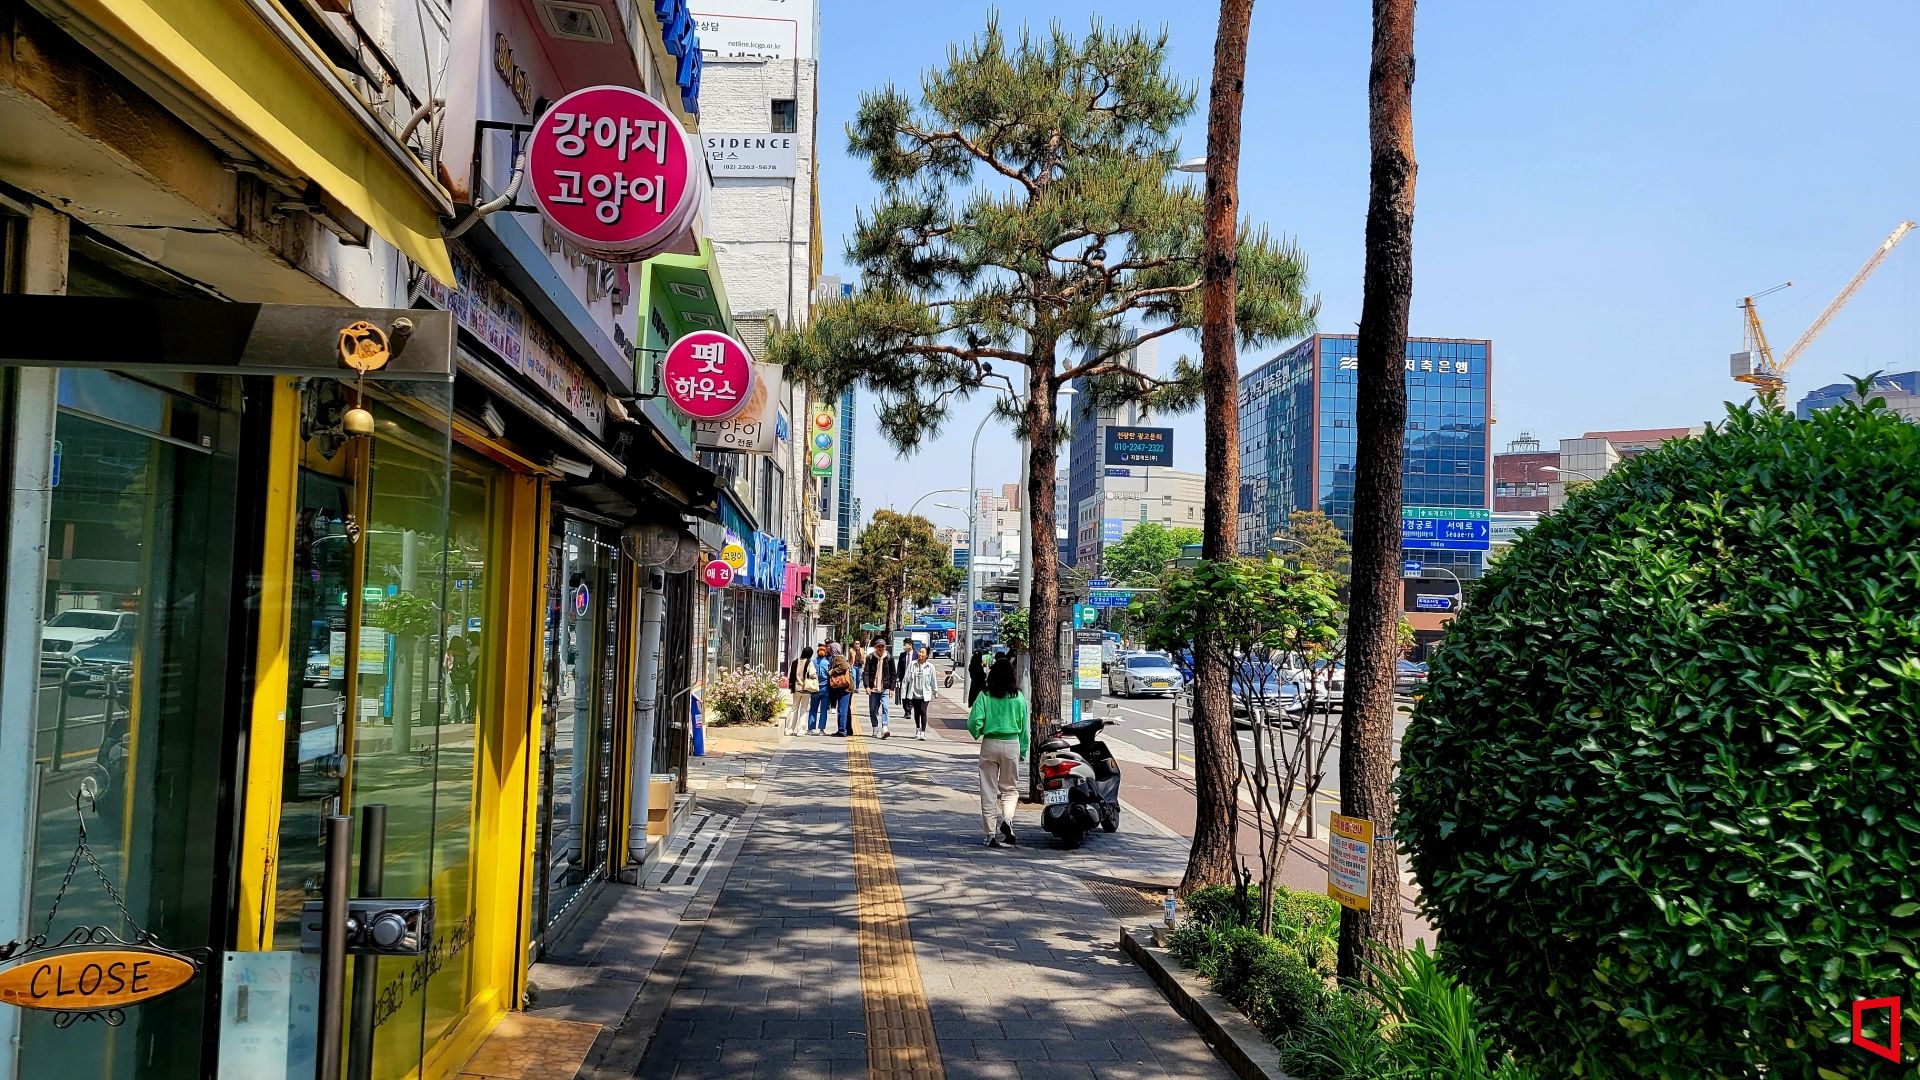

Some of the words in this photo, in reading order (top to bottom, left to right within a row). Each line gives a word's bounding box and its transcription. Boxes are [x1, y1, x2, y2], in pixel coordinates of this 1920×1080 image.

[552, 112, 667, 165] 강아지
[706, 151, 739, 161] 던스
[548, 169, 665, 224] 고양이
[690, 342, 725, 375] 펫
[674, 376, 737, 402] 하우스
[1116, 431, 1136, 440] 전광판
[1137, 432, 1163, 441] 광고문의
[737, 438, 754, 448] 전문
[1114, 442, 1165, 453] 010-2247-2322
[1446, 521, 1473, 530] 서애로
[723, 551, 743, 562] 고양이
[30, 960, 151, 999] CLOSE
